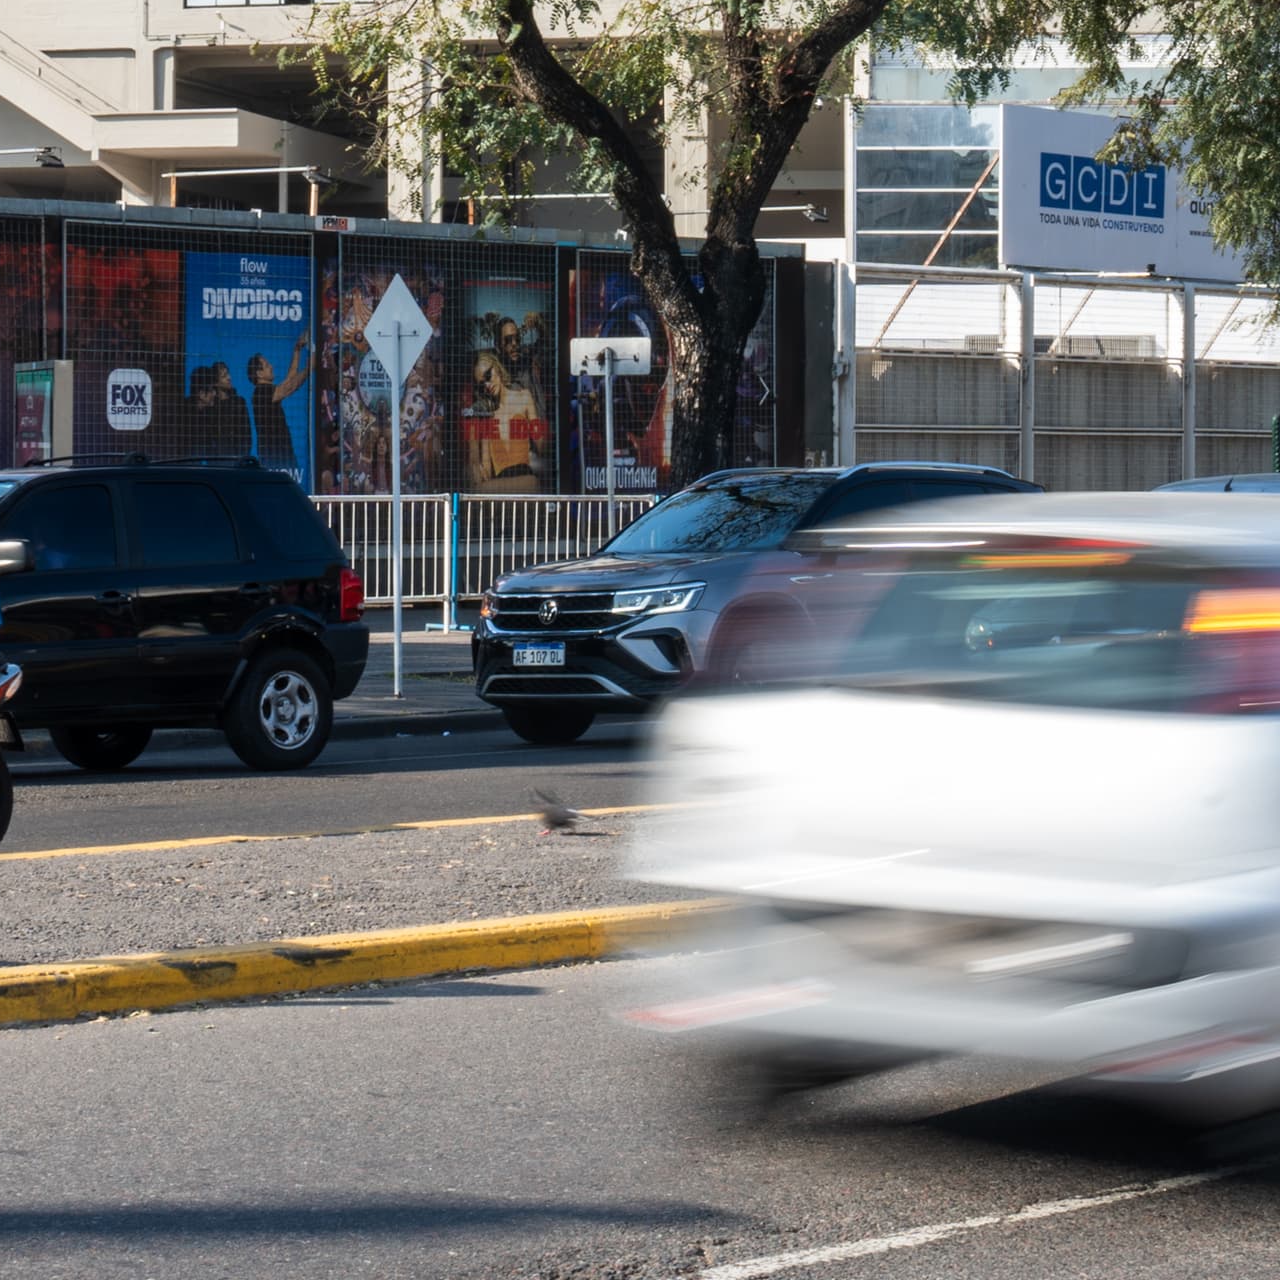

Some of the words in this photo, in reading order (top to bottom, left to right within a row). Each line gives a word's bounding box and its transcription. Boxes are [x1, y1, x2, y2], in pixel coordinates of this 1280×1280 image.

[1043, 161, 1159, 210] GCDI
[1040, 212, 1062, 225] TODA
[1063, 214, 1080, 227] UNA
[1082, 216, 1100, 229] VIDA
[1102, 218, 1165, 235] CONSTRUYENDO
[239, 257, 268, 273] flow
[202, 287, 303, 322] DIVIDIDOS
[369, 359, 383, 371] TO
[111, 384, 147, 406] FOX
[111, 406, 148, 415] SPORTS
[585, 466, 657, 490] QUATUMANIA
[515, 650, 527, 664] AF
[530, 650, 548, 664] 107
